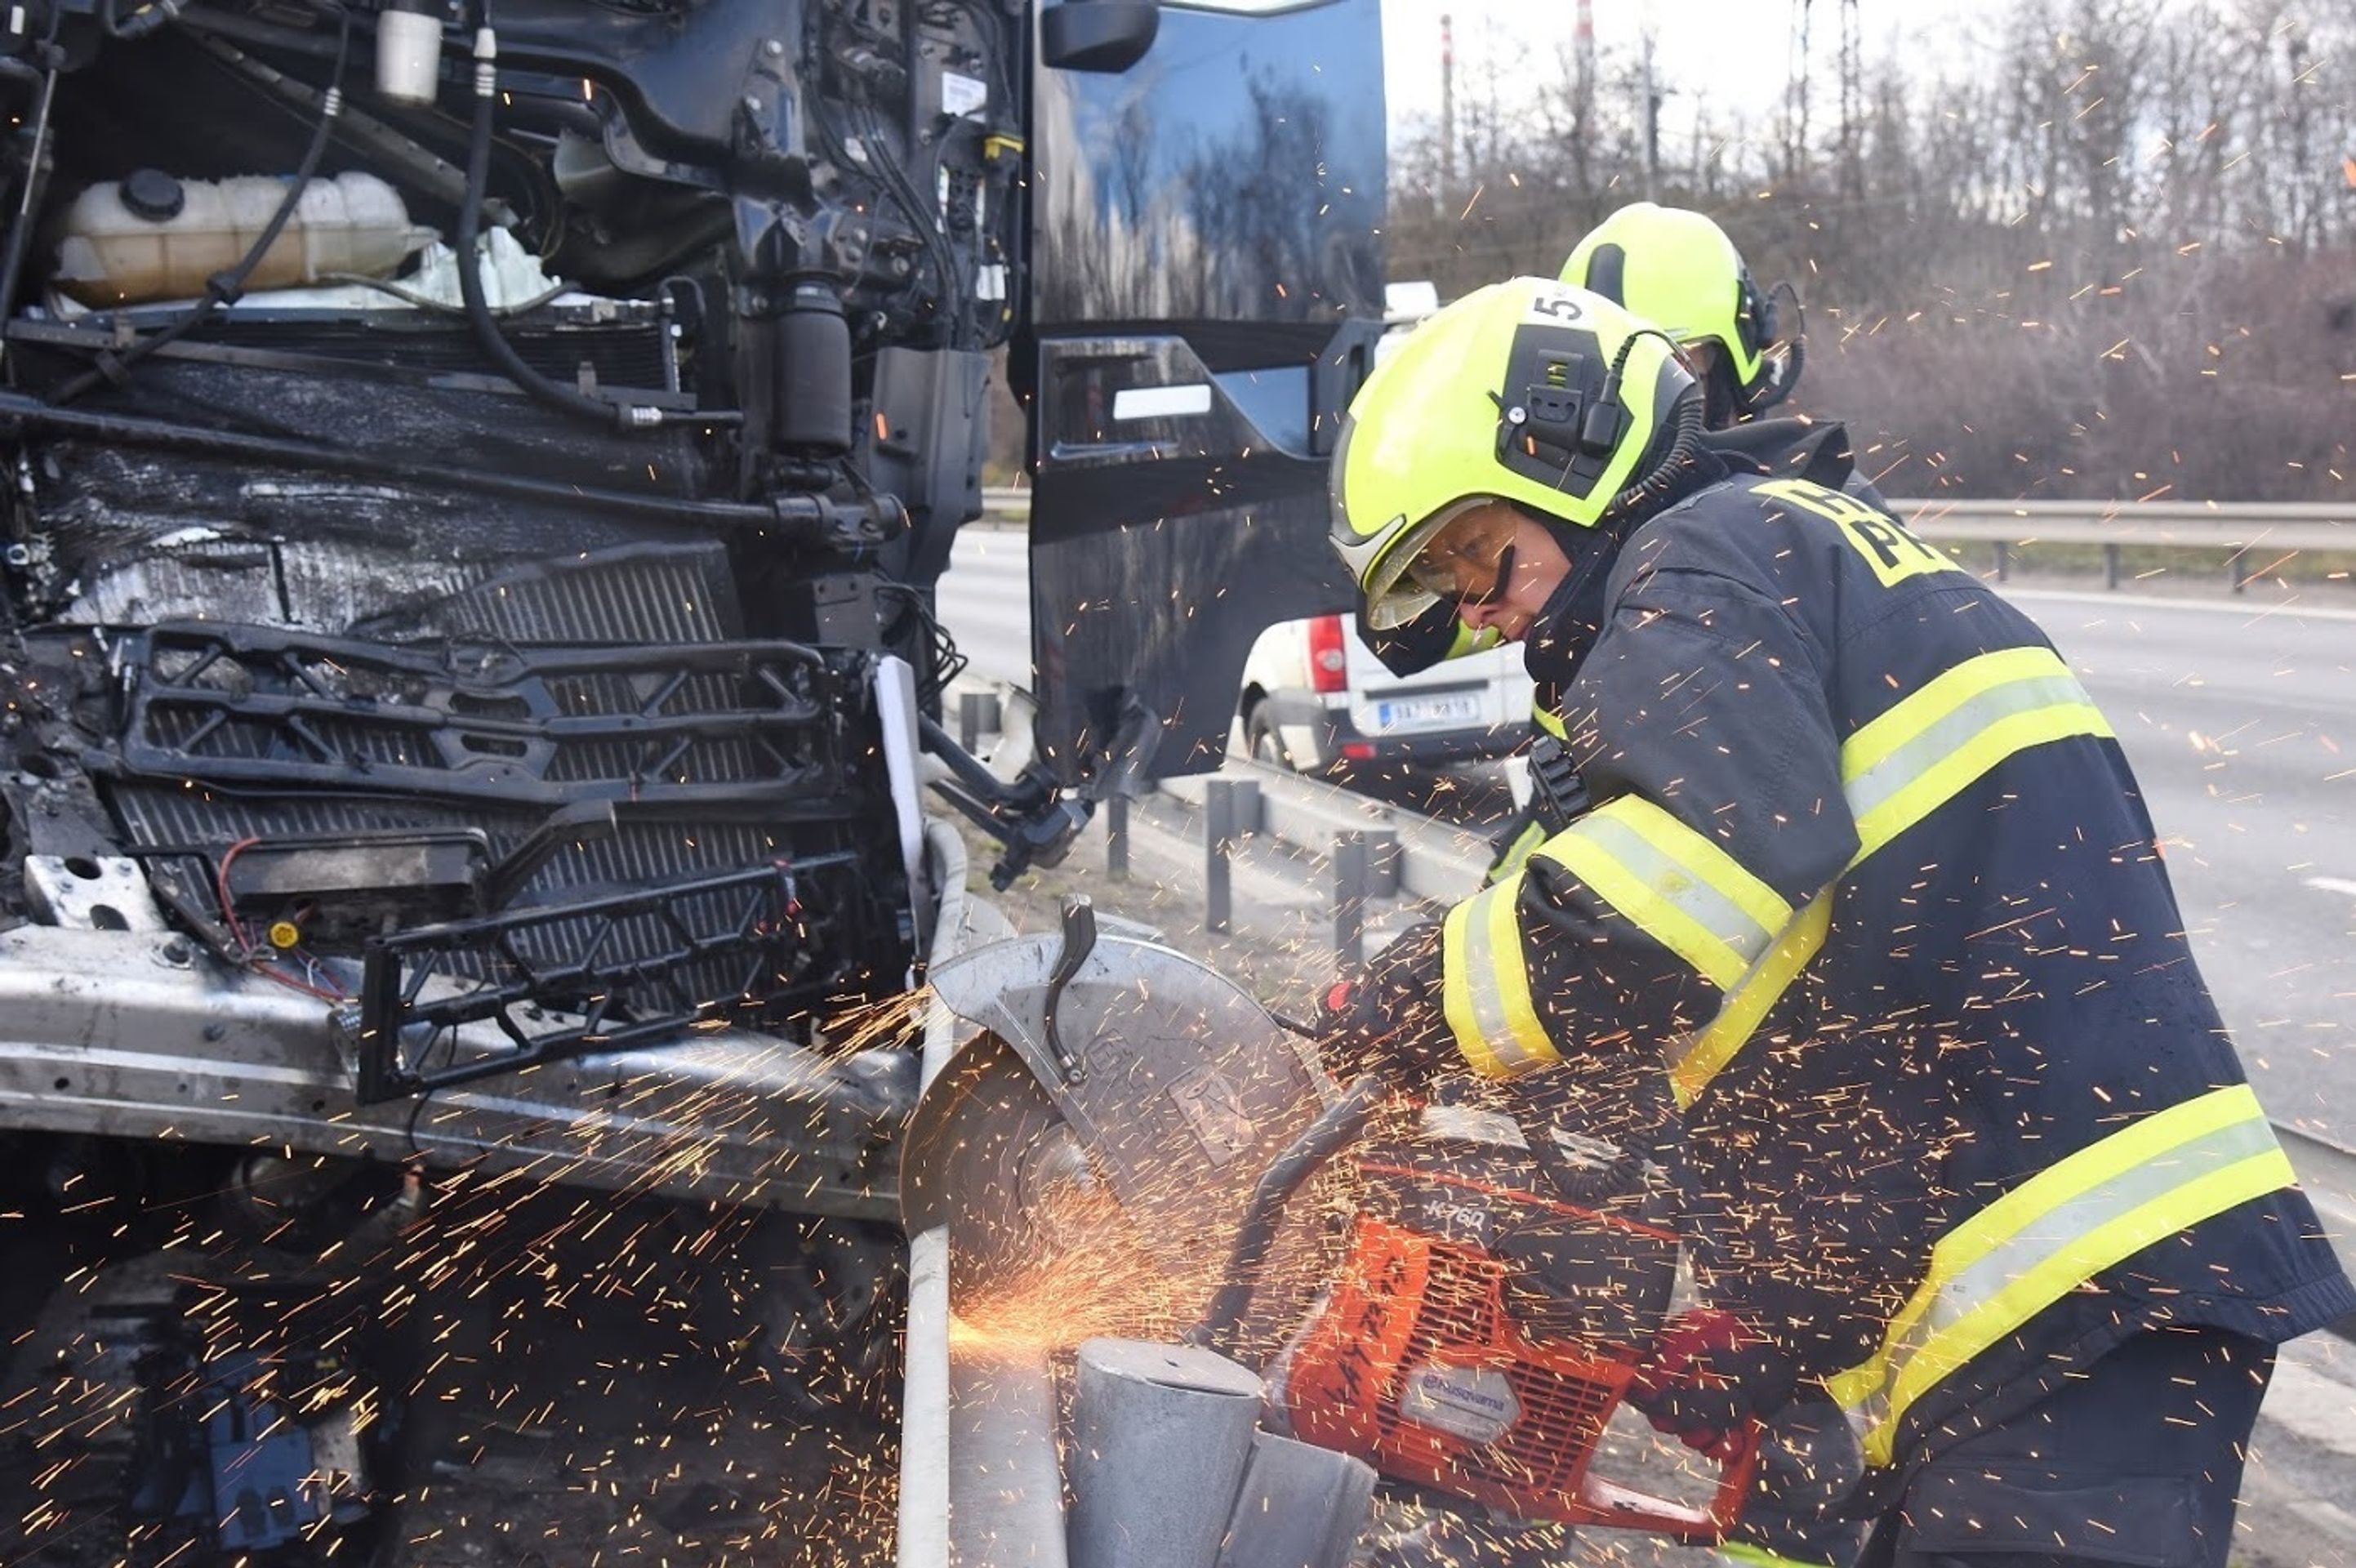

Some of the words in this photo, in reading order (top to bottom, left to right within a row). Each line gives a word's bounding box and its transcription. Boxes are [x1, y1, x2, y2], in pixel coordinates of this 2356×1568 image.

[1534, 296, 1583, 320] 5
[1443, 1203, 1486, 1227] 760
[1438, 1379, 1504, 1412] Husqvarna
